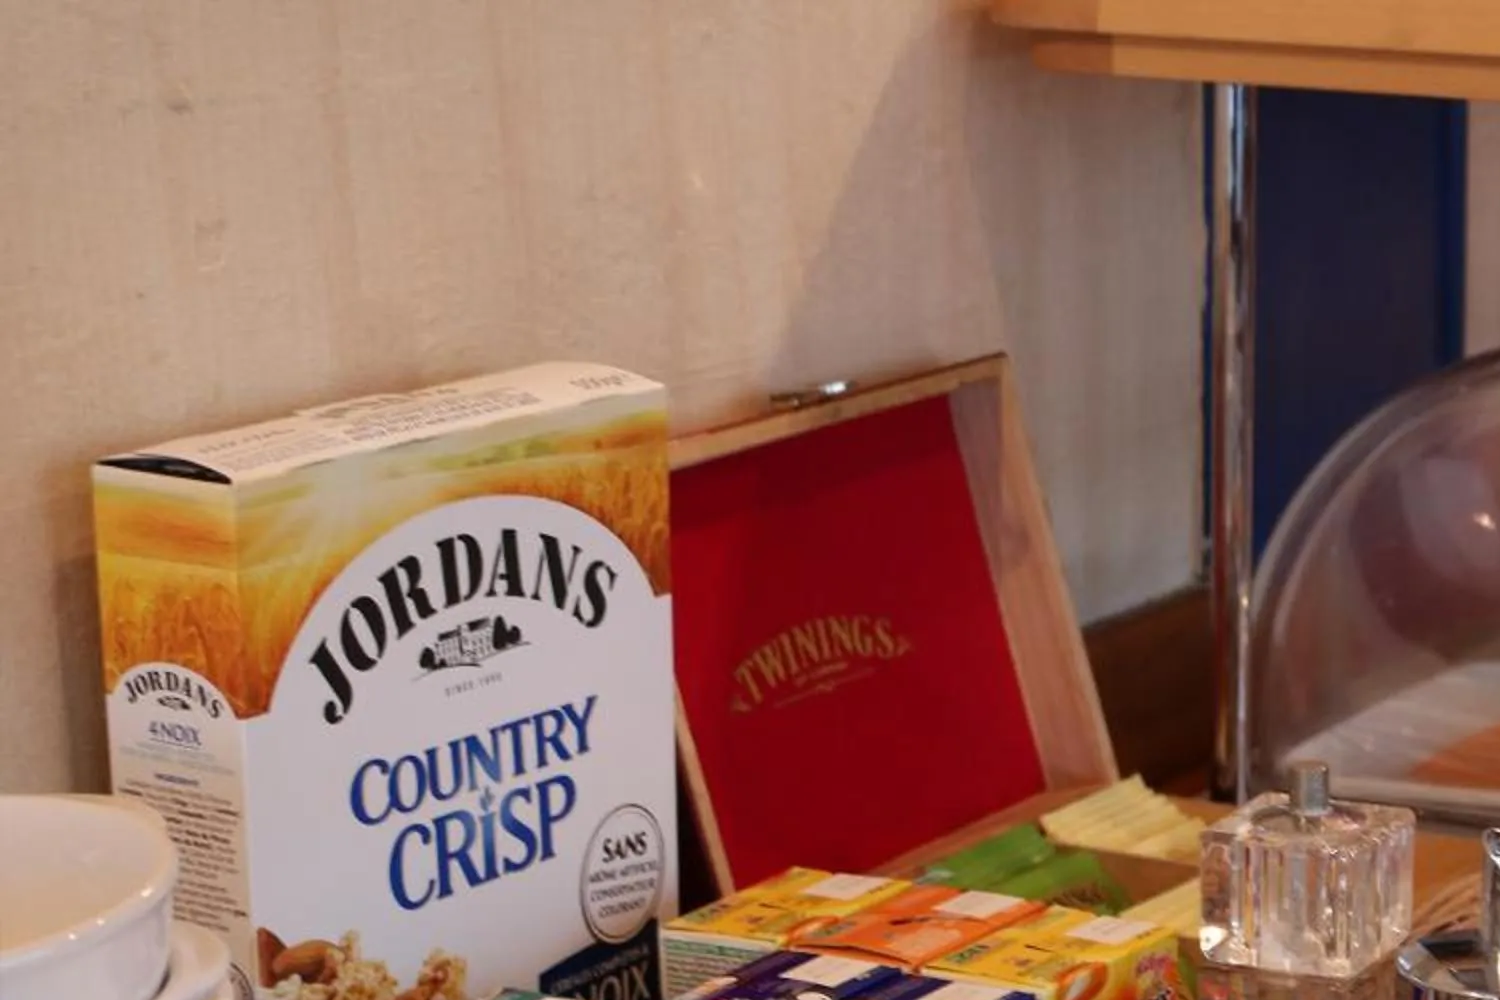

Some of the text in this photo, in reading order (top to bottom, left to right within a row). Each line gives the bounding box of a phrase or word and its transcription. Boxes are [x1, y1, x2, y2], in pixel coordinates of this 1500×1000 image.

[308, 528, 619, 725] JORDANS
[733, 614, 895, 704] TWININGS
[124, 670, 223, 719] JORDANS
[349, 695, 599, 826] COUNTRY
[388, 774, 577, 911] CRISP
[602, 831, 648, 863] SANS
